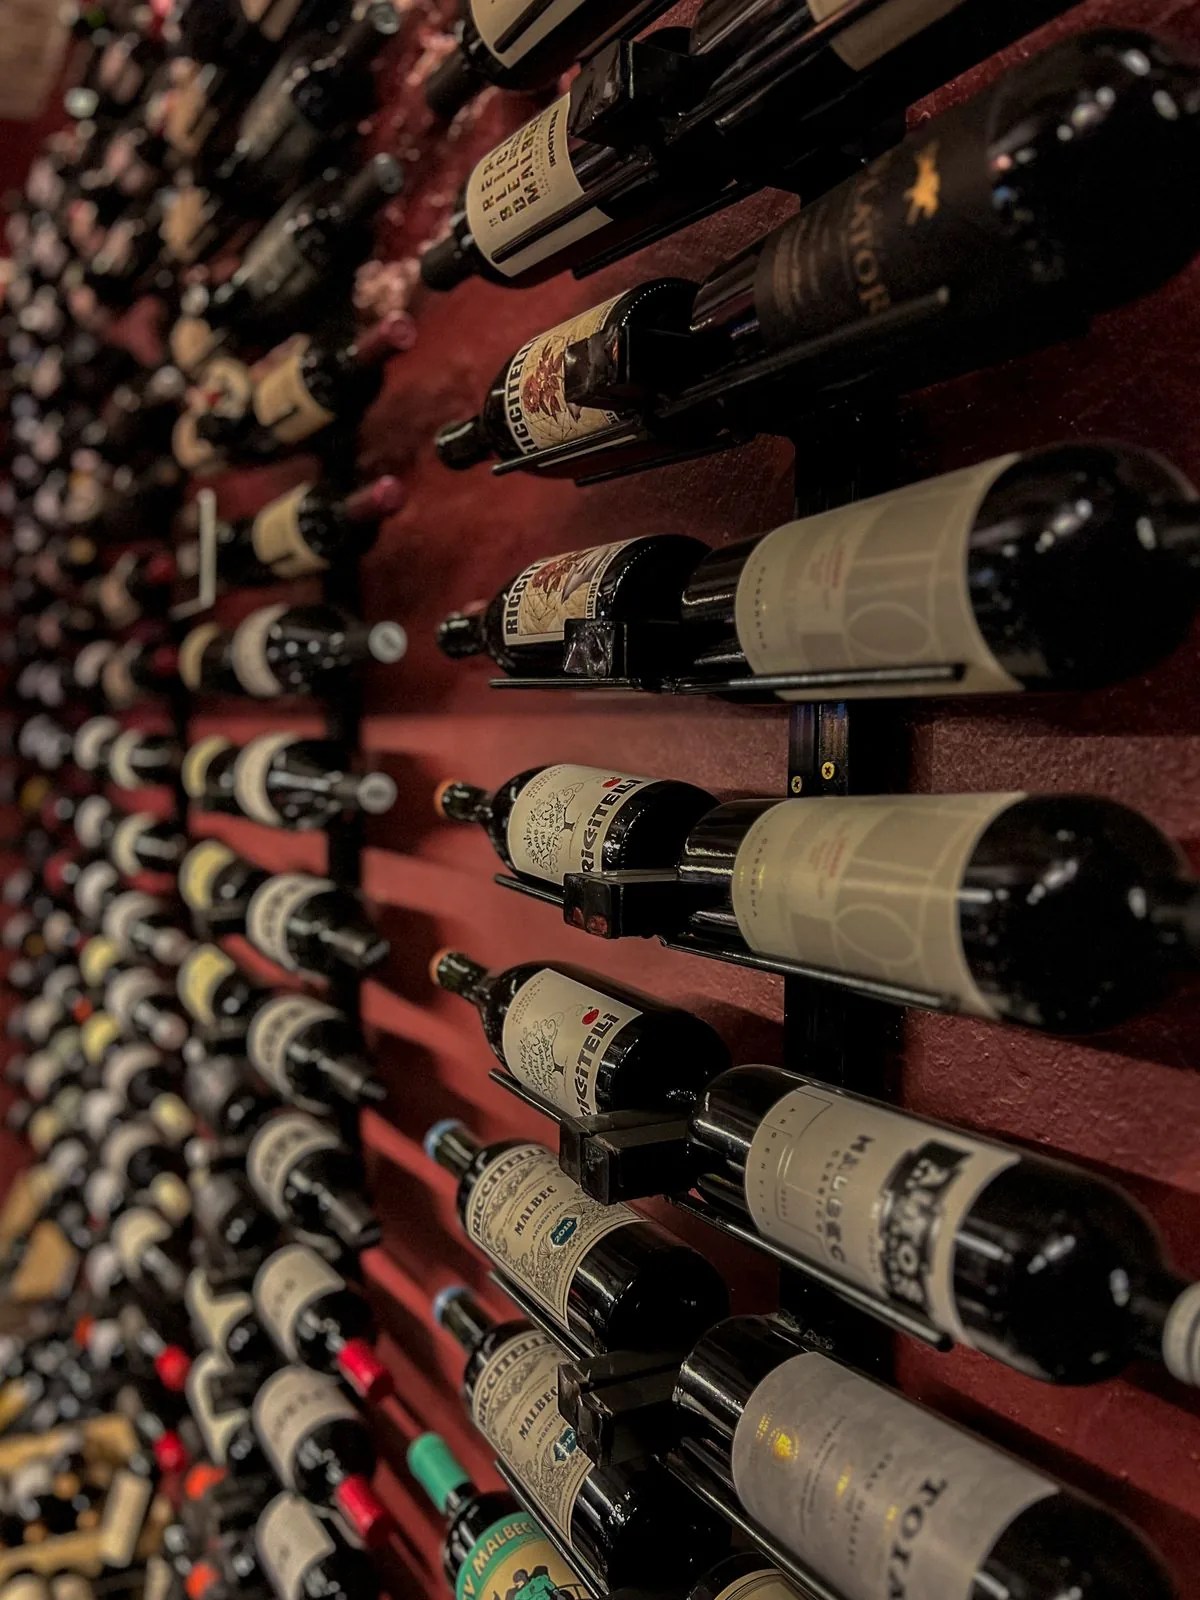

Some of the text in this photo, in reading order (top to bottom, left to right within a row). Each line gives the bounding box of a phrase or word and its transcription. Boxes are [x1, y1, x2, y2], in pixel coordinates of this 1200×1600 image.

[505, 560, 544, 635] RICCIT
[471, 1149, 548, 1238] RICCITELLI
[513, 1184, 558, 1237] MALBEC
[531, 1201, 565, 1241] ARGENTINA
[825, 1133, 876, 1265] MALBEC
[555, 1220, 573, 1244] 2018
[518, 1384, 559, 1441] MALBEC
